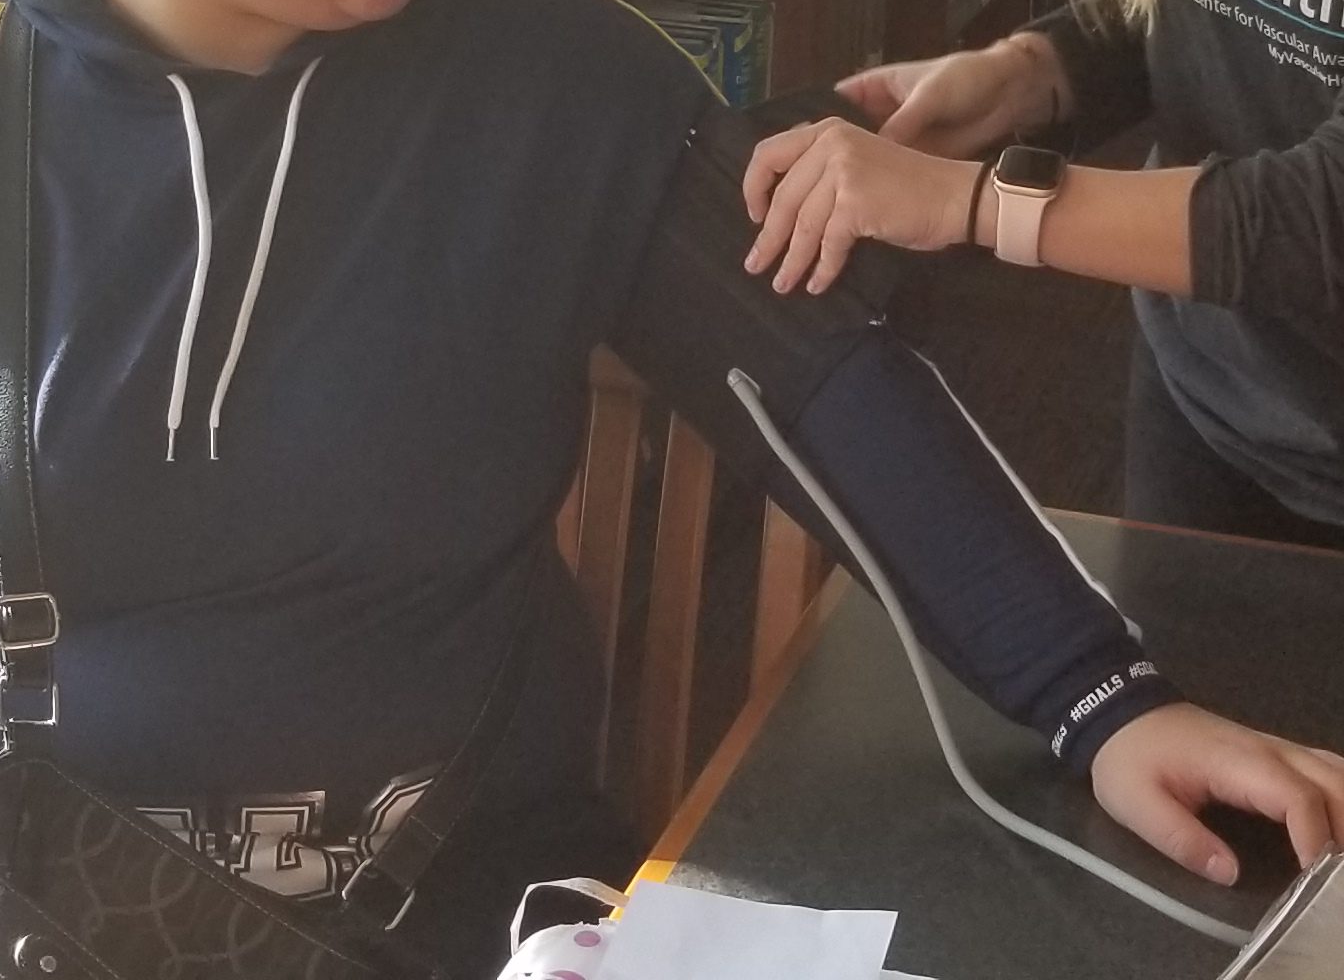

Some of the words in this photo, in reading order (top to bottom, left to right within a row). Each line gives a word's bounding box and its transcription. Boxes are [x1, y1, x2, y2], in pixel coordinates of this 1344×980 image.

[1233, 6, 1257, 27] for
[1256, 18, 1310, 55] Vascular
[1069, 674, 1125, 723] #GOALS
